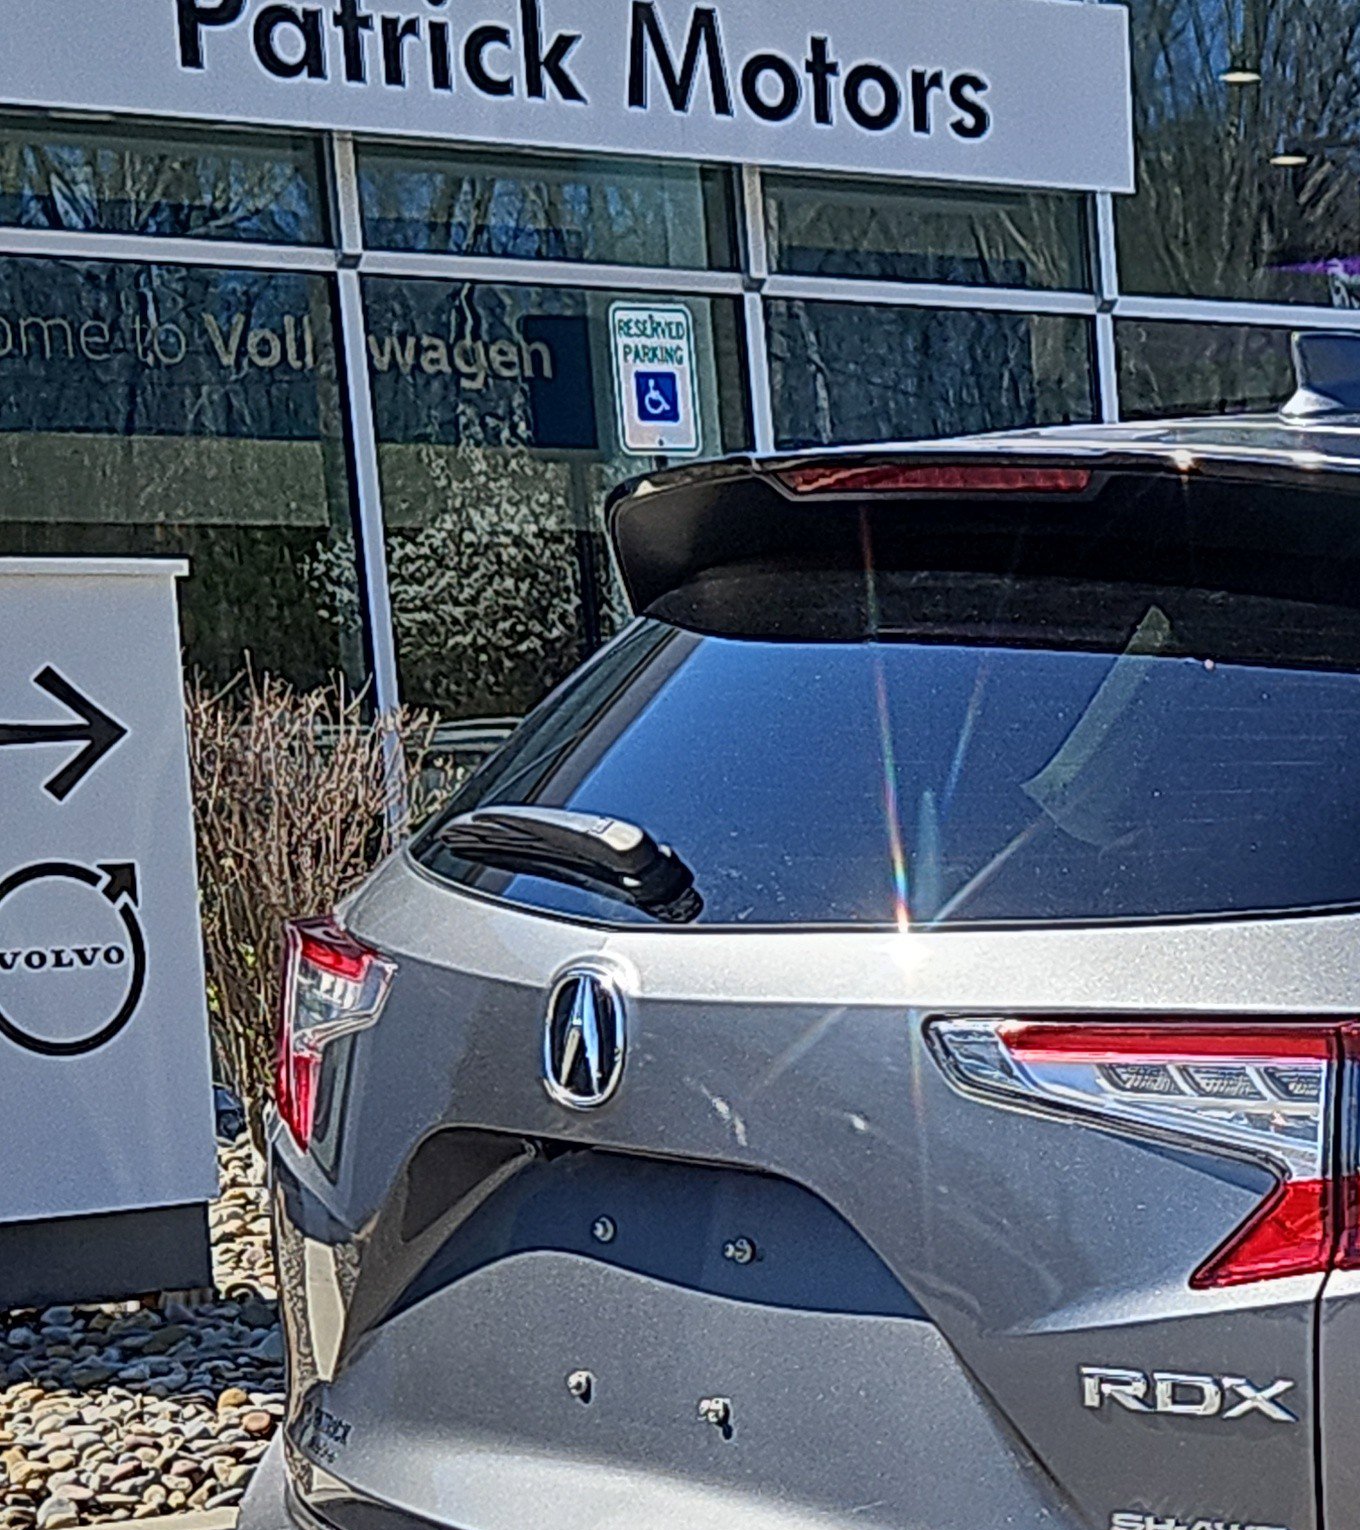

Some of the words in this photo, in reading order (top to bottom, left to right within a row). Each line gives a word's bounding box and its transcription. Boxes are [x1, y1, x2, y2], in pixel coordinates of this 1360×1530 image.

[176, 0, 589, 106] Patrick
[627, 0, 990, 139] Motors
[132, 314, 187, 364] to
[617, 318, 686, 340] RESERVED
[623, 343, 685, 365] PARKING
[0, 945, 125, 970] VOLVO
[1080, 1365, 1299, 1423] RDX
